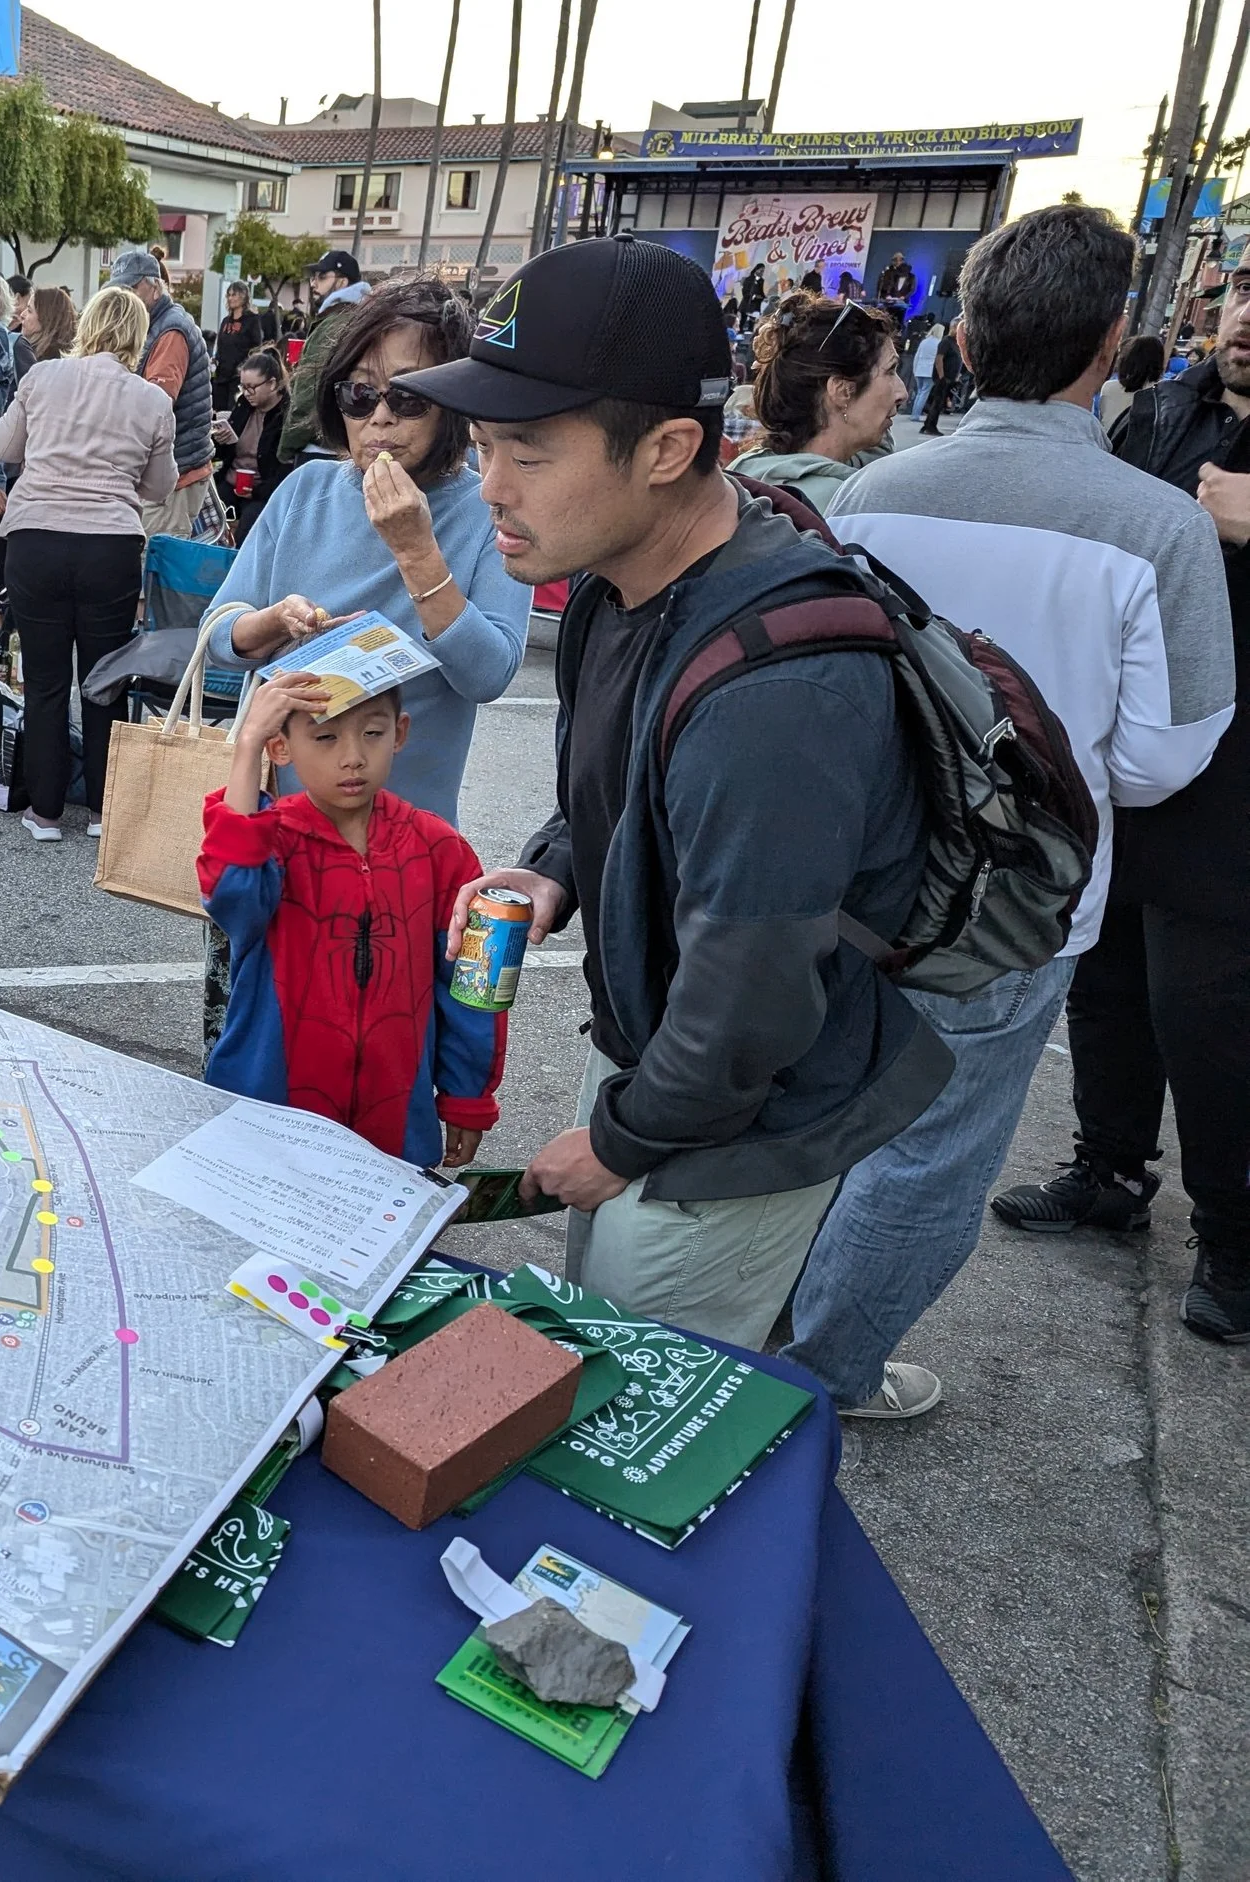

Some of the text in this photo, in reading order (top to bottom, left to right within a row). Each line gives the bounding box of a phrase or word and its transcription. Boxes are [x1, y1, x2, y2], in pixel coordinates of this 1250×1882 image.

[680, 120, 1075, 147] MILLBRAE MACHINES CAR, TRUCK AND BIKE SHOW
[934, 143, 961, 153] CLUB
[792, 203, 871, 235] Brews
[767, 235, 849, 263] & Vines
[45, 1073, 104, 1097] MILLBRAE
[257, 1238, 278, 1250] Real
[277, 1246, 317, 1265] Camino
[52, 1285, 67, 1324] Huntington
[133, 1291, 210, 1302] San Felipe Ave
[137, 1365, 159, 1377] Ave
[51, 1402, 108, 1436] BRUNO
[53, 1417, 87, 1439] SAN
[646, 1413, 708, 1476] ADVENTURE
[703, 1374, 743, 1419] STARTS
[29, 1444, 136, 1474] San Bruno Ave W
[561, 1440, 616, 1468] .ORG
[213, 1575, 246, 1594] HE
[3, 1648, 40, 1678] 35
